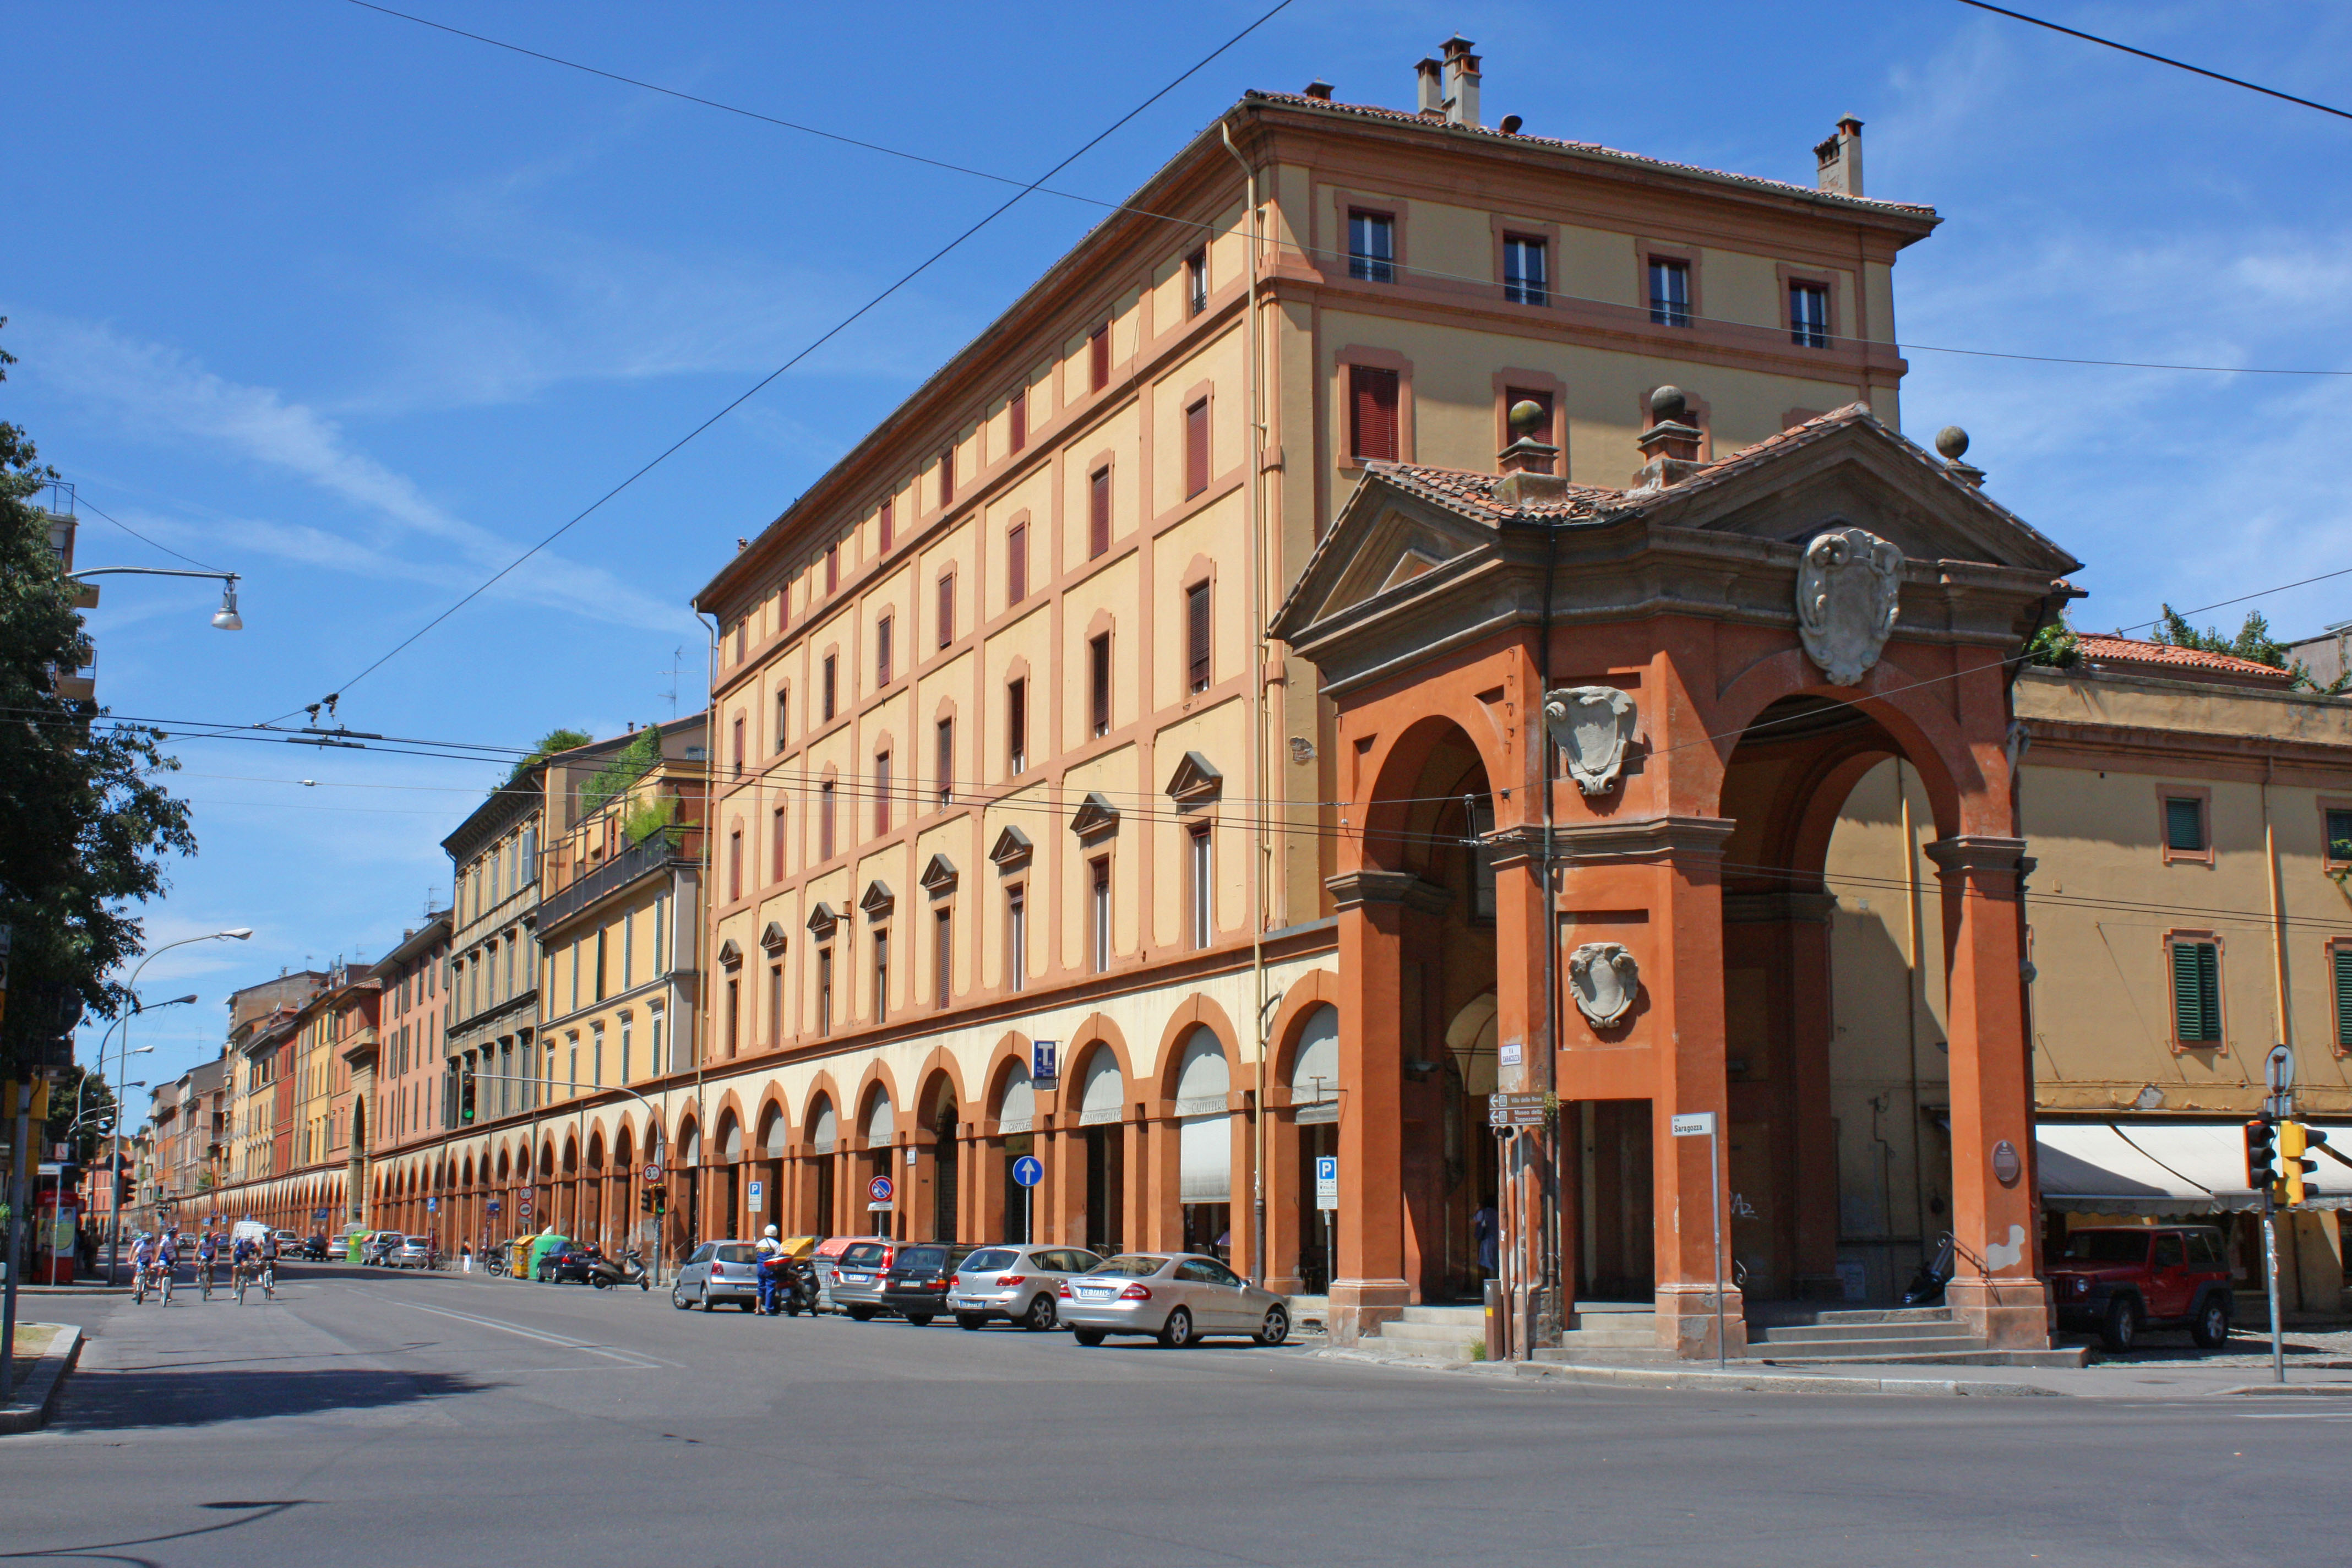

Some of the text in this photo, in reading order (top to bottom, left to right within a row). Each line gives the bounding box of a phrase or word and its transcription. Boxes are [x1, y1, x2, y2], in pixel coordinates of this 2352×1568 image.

[1038, 1043, 1053, 1065] T
[1674, 1125, 1702, 1133] Saragozza
[1322, 1162, 1332, 1177] P
[752, 1185, 758, 1194] P
